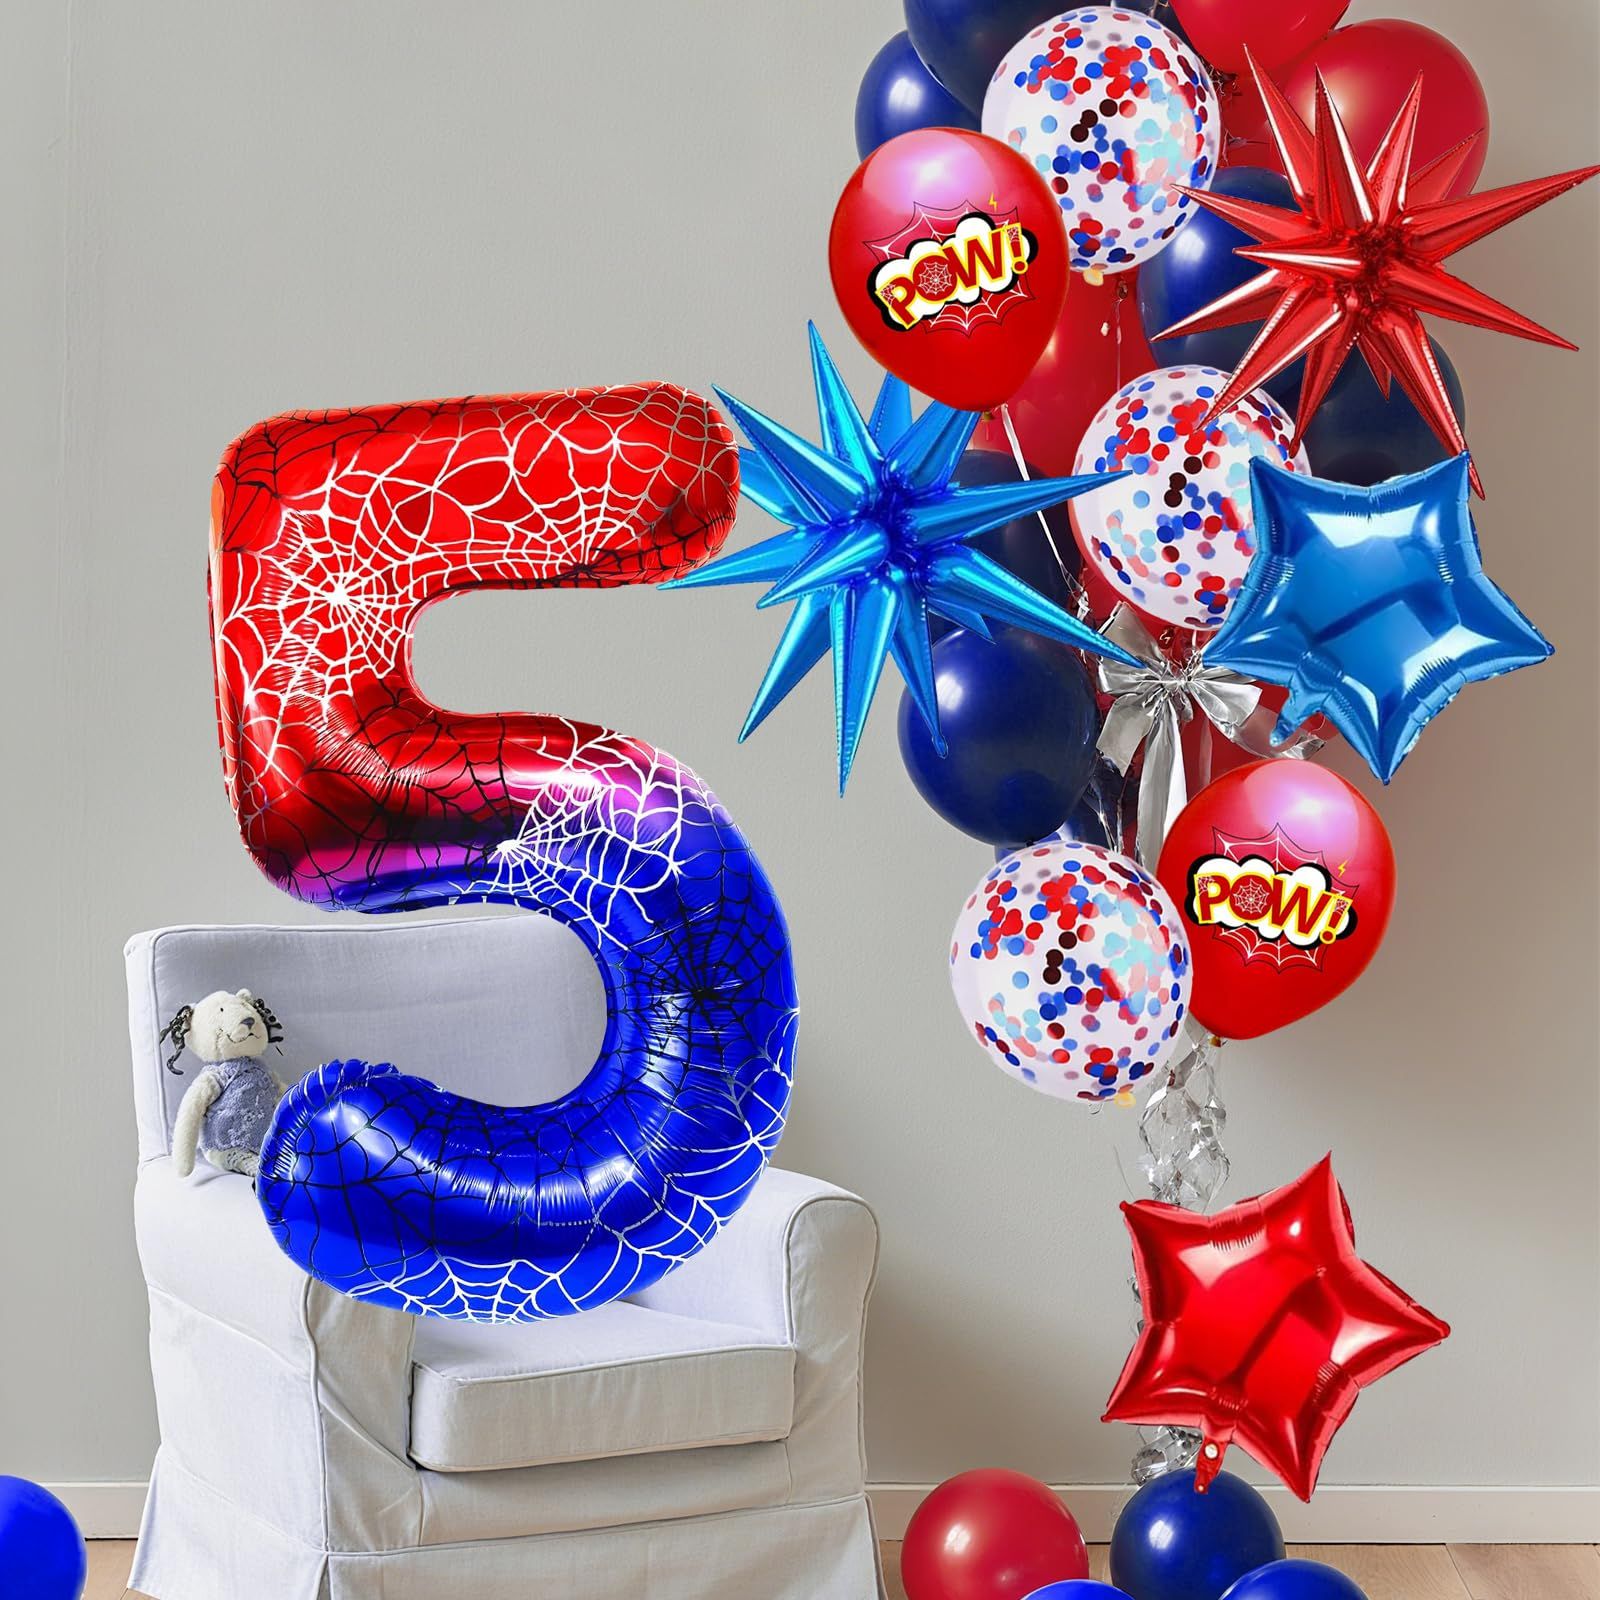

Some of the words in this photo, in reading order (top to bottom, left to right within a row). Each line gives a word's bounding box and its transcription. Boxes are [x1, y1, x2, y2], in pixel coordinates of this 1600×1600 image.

[875, 222, 1028, 329] POW!
[208, 381, 799, 1325] 5
[1194, 871, 1353, 944] POW!
